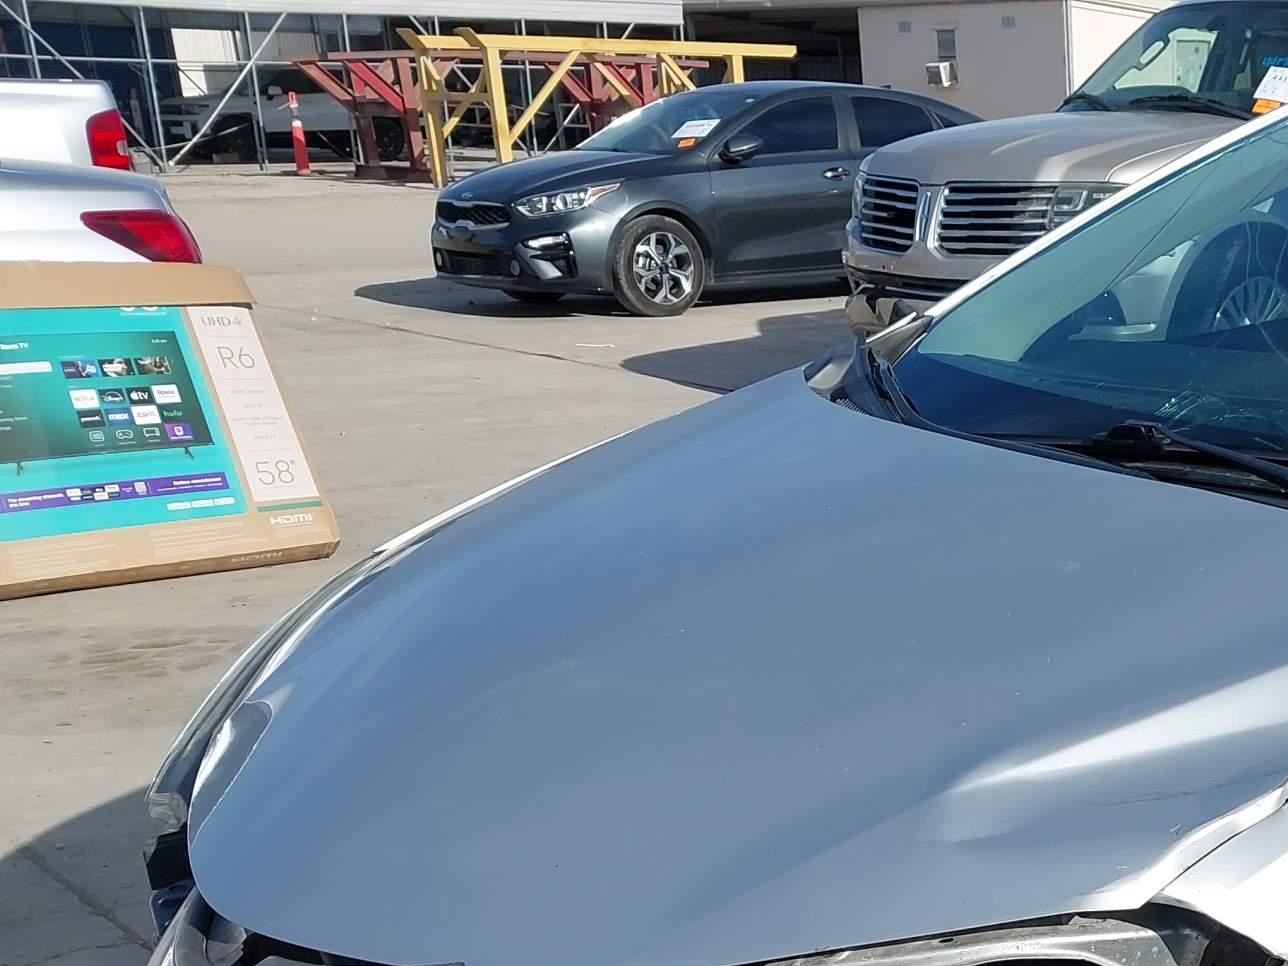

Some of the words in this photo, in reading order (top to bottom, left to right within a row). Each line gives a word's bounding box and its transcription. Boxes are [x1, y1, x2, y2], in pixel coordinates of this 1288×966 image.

[200, 316, 231, 327] UHD
[216, 346, 256, 369] R6
[255, 459, 296, 485] 58"
[269, 512, 313, 527] HDMI
